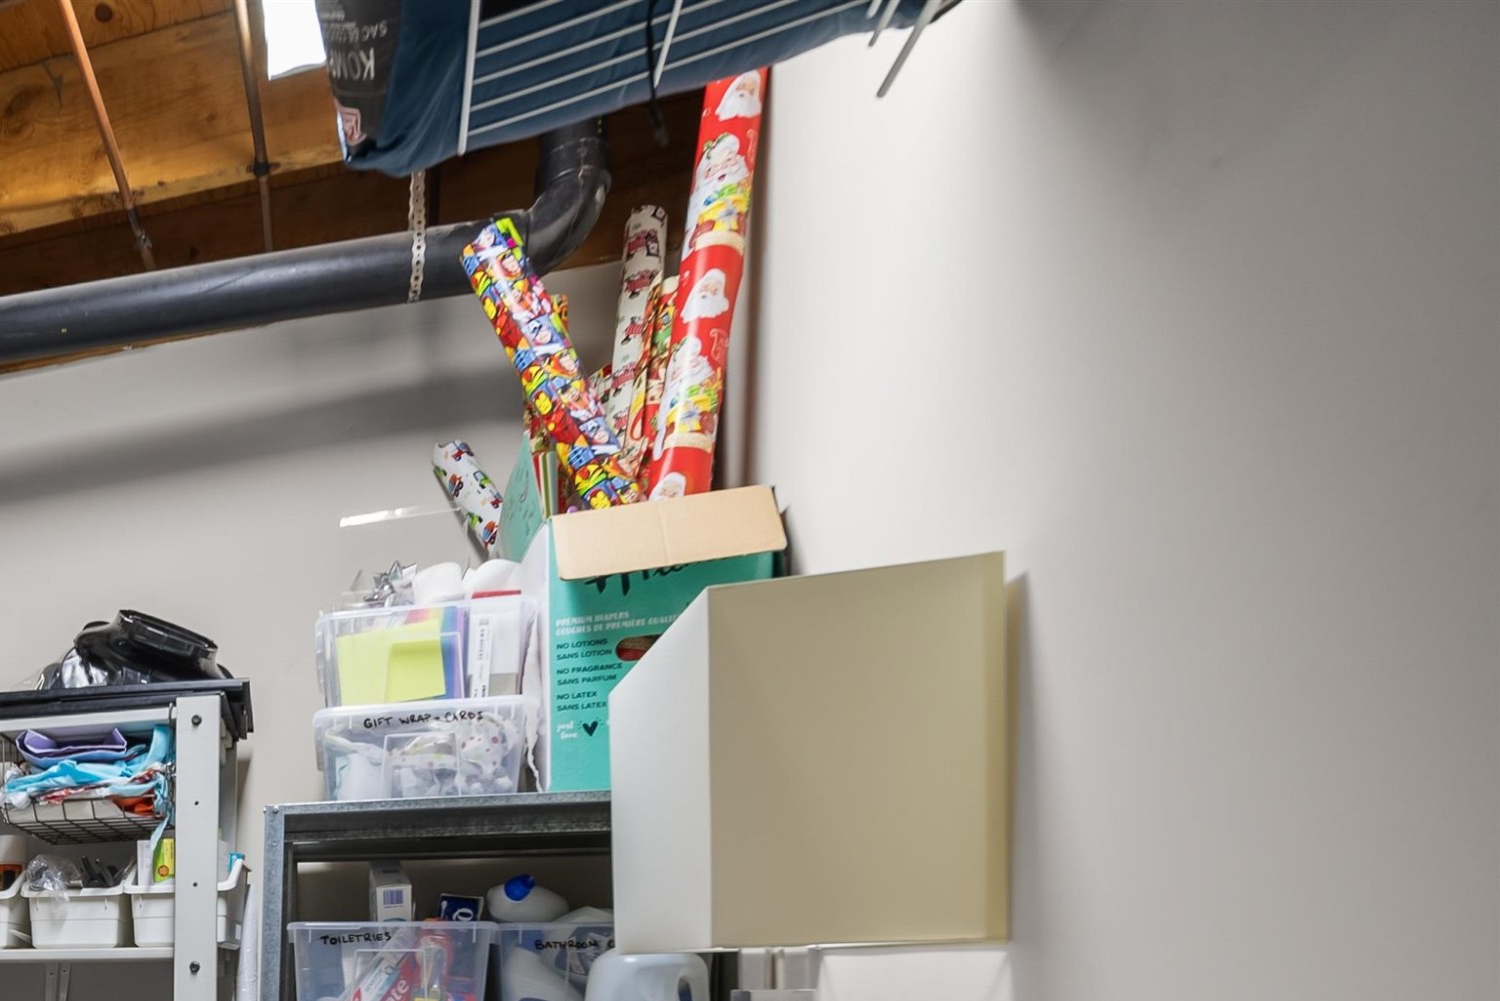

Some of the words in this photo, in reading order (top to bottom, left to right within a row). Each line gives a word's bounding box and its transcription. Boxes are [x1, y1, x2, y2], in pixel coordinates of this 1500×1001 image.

[555, 614, 593, 627] PREMIUM
[594, 610, 630, 622] DIAPERS
[555, 624, 591, 637] COUCHES
[593, 622, 604, 632] DE
[647, 613, 678, 625] QUALIT
[571, 638, 608, 648] LOTIONS
[580, 649, 612, 658] LOTION
[571, 662, 623, 673] FRAGRANCE
[557, 678, 580, 686] SANS
[581, 674, 617, 683] PARFUM
[571, 691, 597, 699] LATEX
[581, 701, 607, 710] LATEX
[363, 717, 393, 730] GIFT
[400, 712, 432, 725] WRAP
[556, 720, 574, 733] just
[319, 931, 392, 945] TOILETRIES
[535, 939, 600, 951] BATHROOM
